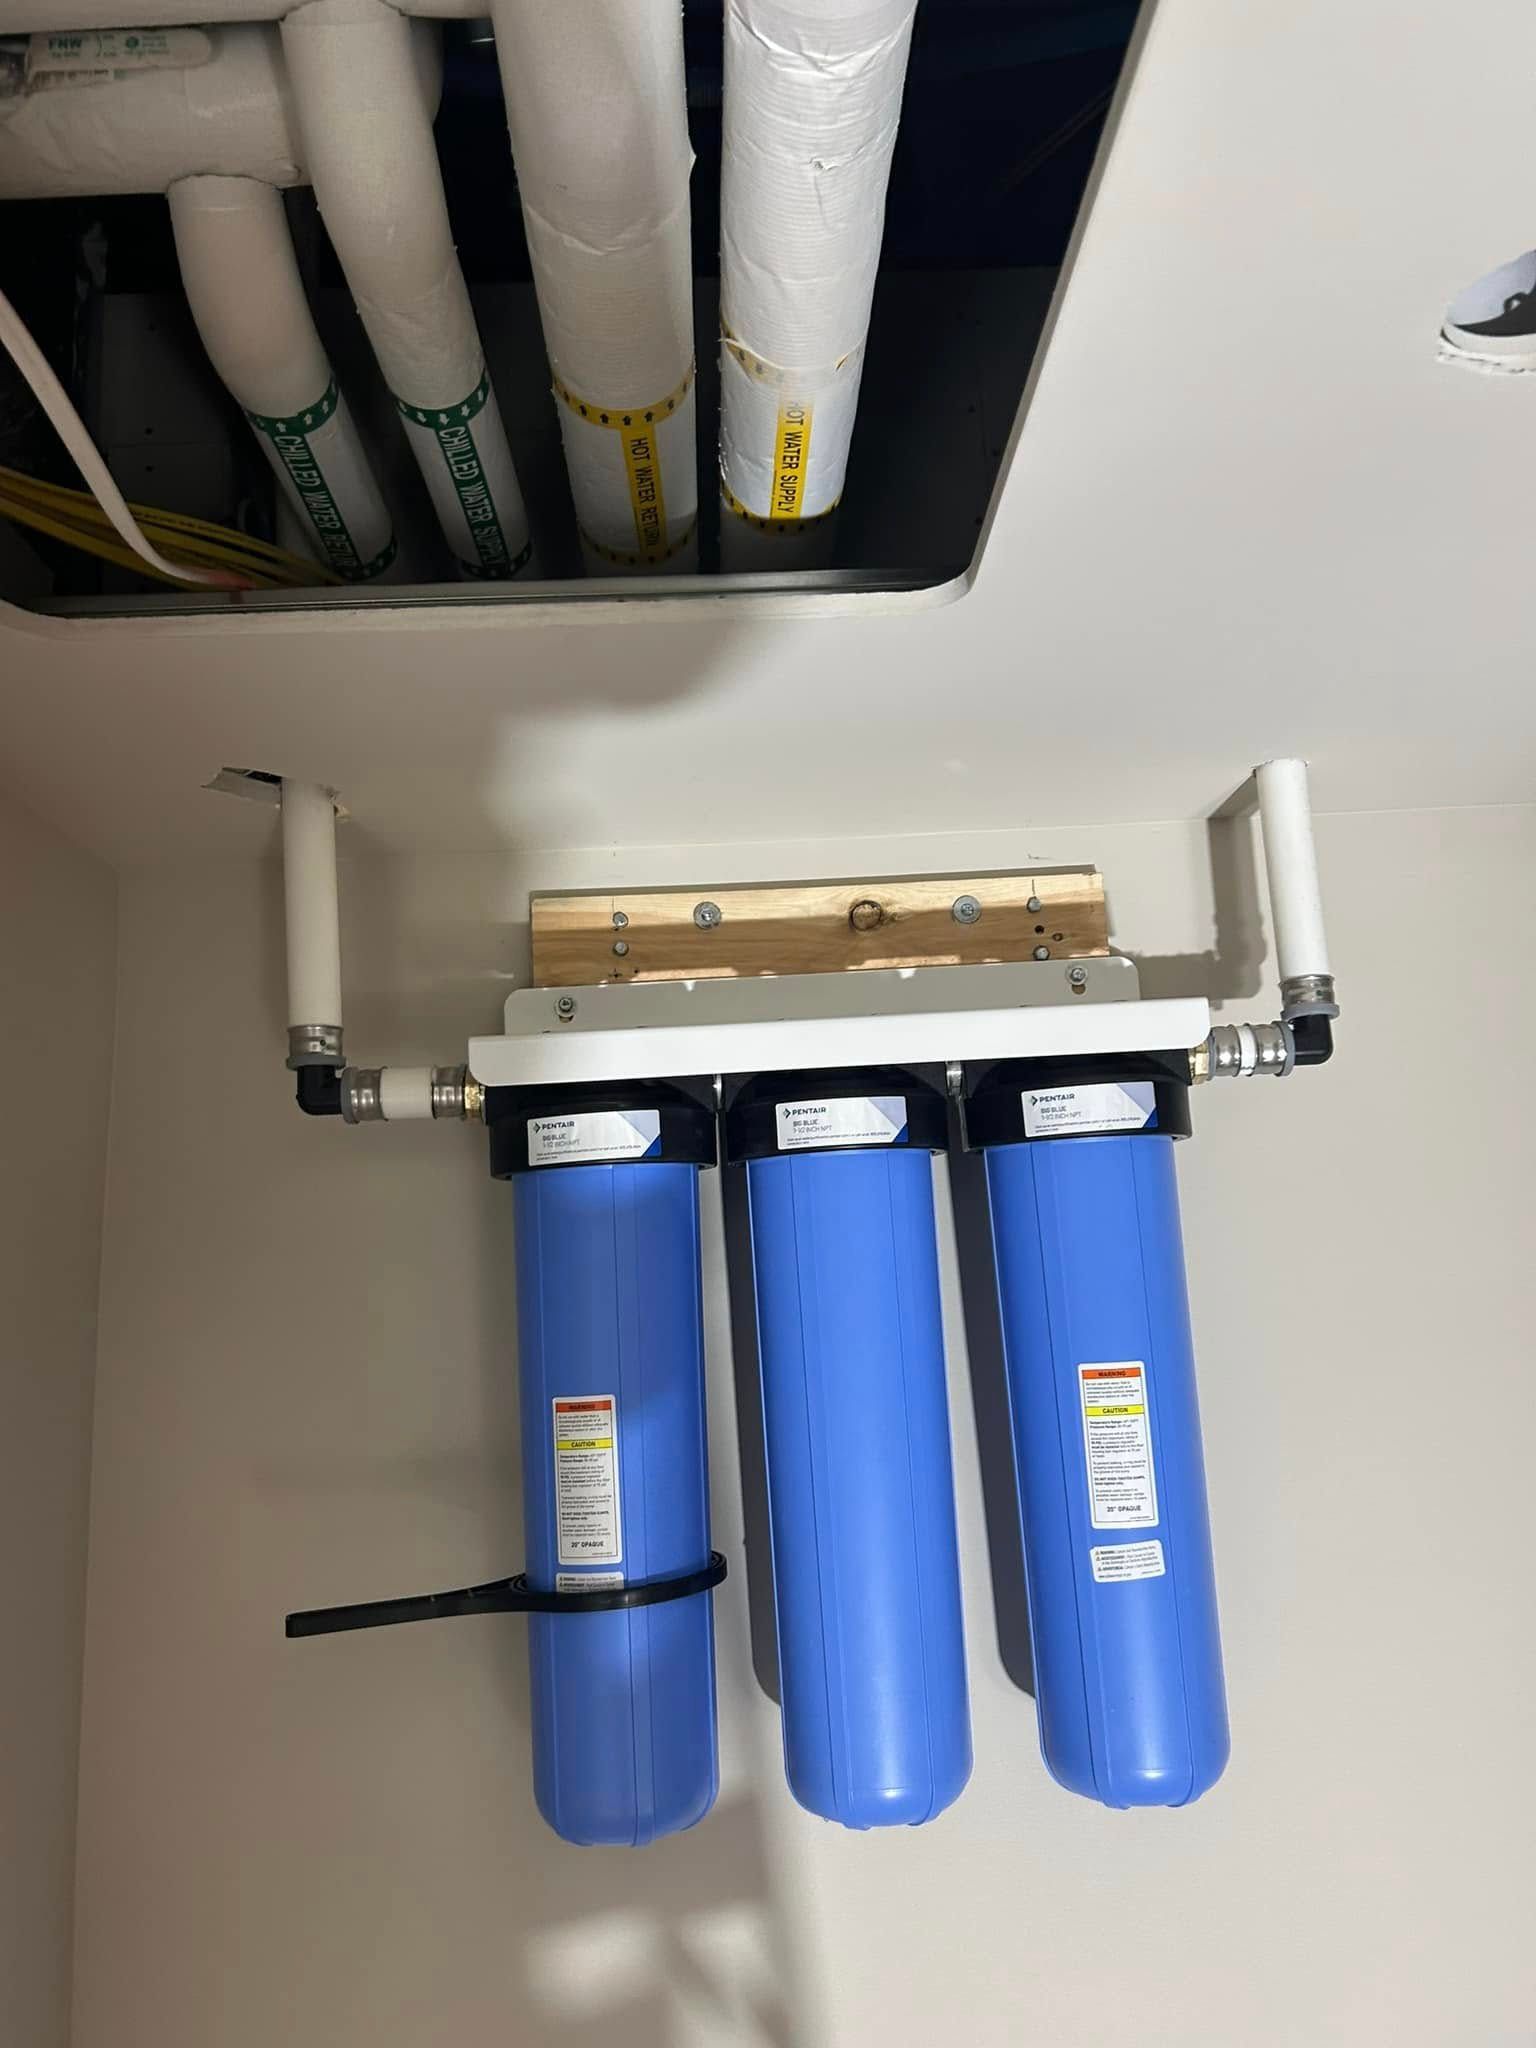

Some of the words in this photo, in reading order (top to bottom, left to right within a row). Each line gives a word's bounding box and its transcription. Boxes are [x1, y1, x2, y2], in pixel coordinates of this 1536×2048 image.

[630, 437, 650, 461] HOT
[782, 431, 804, 470] WATER
[274, 435, 321, 488] CHILLED
[302, 489, 341, 530] WATER
[439, 425, 479, 481] CHILLED
[459, 481, 494, 525] WATER
[634, 465, 656, 504] WATER
[778, 474, 798, 513] SUPPLY
[1039, 1093, 1075, 1103] PENTAIR
[1051, 1105, 1067, 1113] BLUE
[792, 1107, 827, 1116] PENTAIR
[803, 1118, 819, 1126] BLUE
[542, 1120, 575, 1130] PENTAIR
